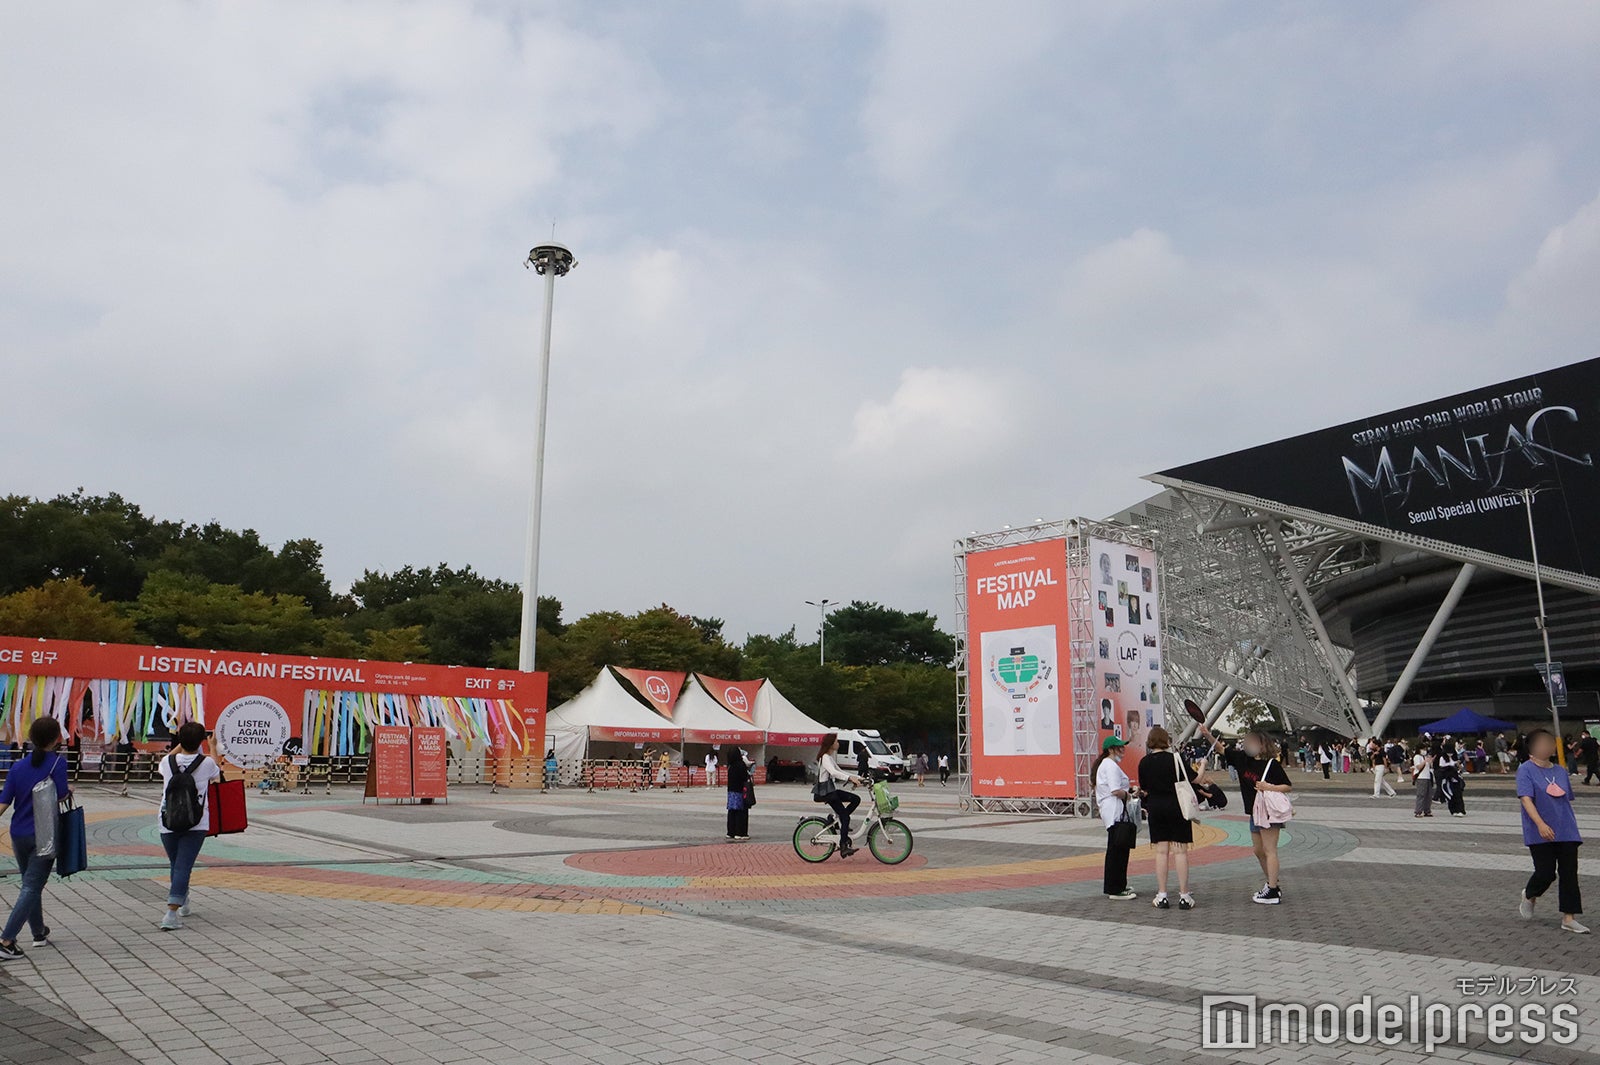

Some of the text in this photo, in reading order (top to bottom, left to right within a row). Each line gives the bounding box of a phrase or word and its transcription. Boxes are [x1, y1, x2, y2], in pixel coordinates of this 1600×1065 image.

[1352, 387, 1543, 446] STRAY KIDS 2ND WORLD TOUR
[1408, 507, 1437, 524] Seoul
[1437, 500, 1476, 520] Special
[1477, 494, 1521, 513] (UNVEIL
[977, 568, 1058, 595] FESTIVAL
[997, 589, 1037, 611] MAP
[31, 650, 58, 665] 입구
[1120, 646, 1137, 661] LAF
[138, 655, 366, 683] LISTEN AGAIN FESTIVAL
[465, 677, 492, 689] EXIT
[648, 684, 667, 696] LAF
[727, 694, 744, 705] LAF
[226, 703, 244, 718] LISTEN
[263, 700, 283, 720] FESTIVAL
[237, 720, 271, 728] LISTEN
[238, 728, 268, 736] AGAIN
[230, 736, 274, 745] FESTIVAL
